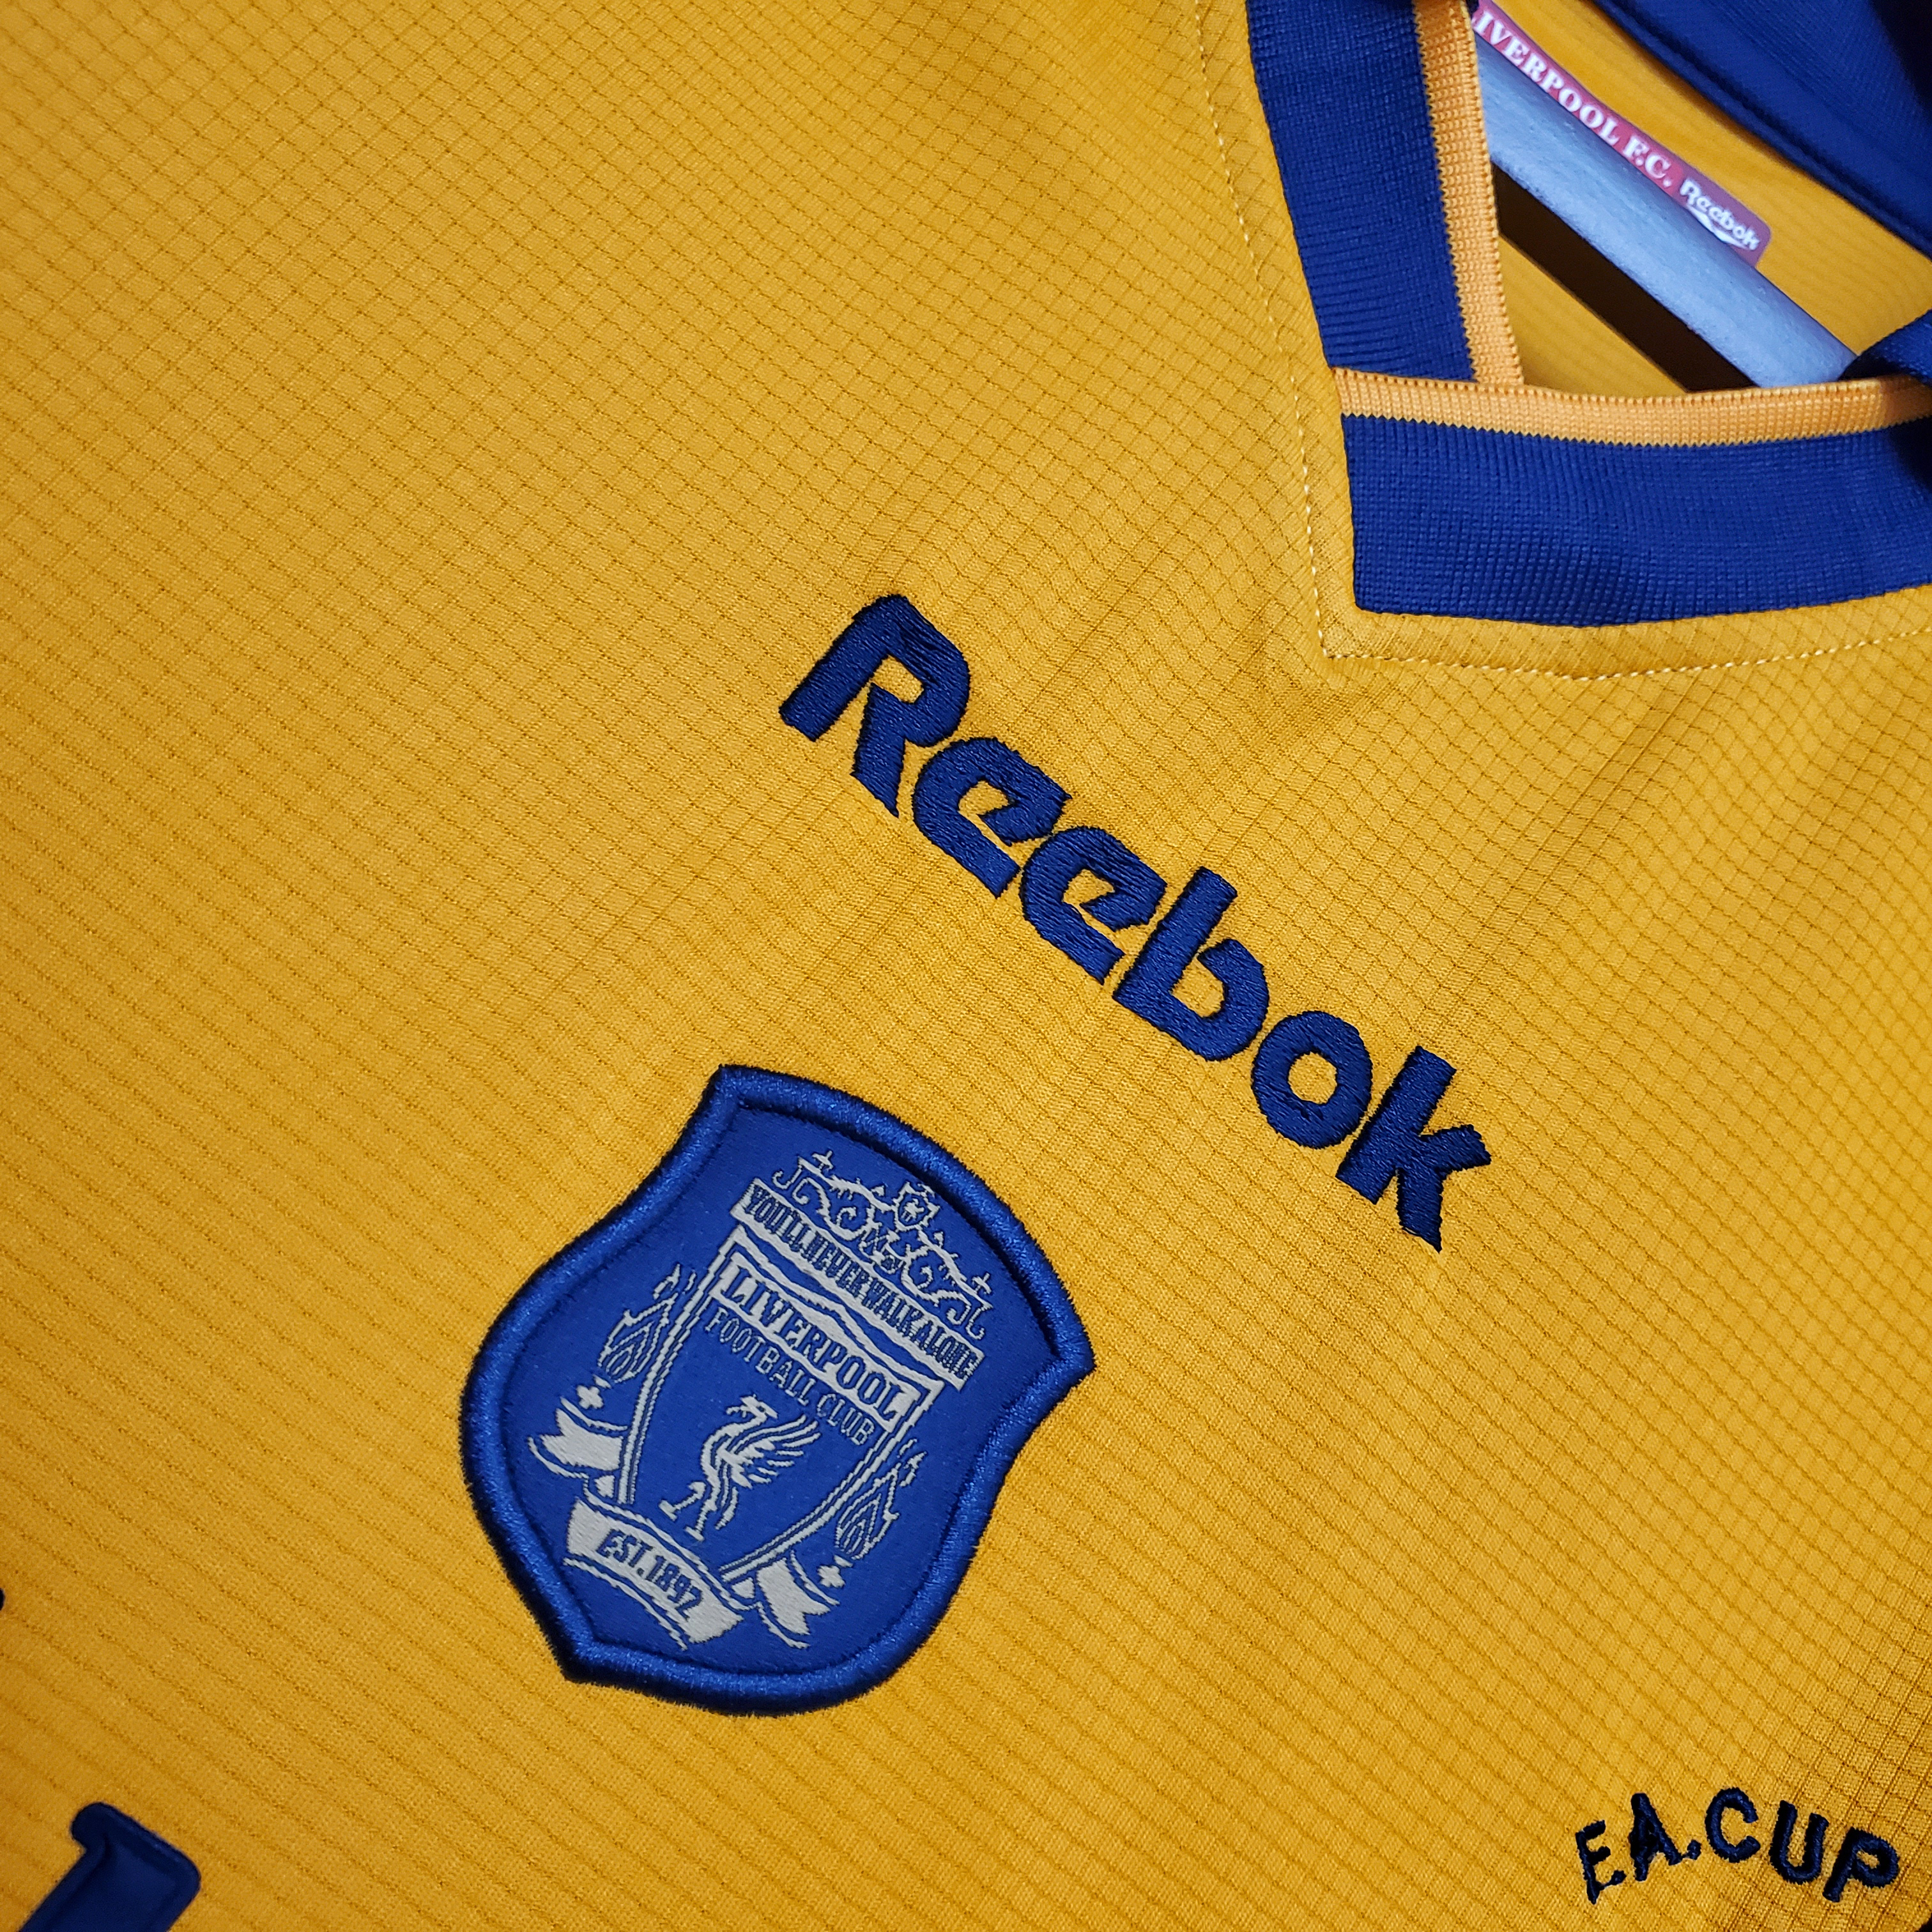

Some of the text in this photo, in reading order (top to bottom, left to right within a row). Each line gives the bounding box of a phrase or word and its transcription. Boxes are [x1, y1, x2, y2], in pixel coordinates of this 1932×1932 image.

[1471, 11, 1671, 187] IVERPOOL F.C.
[1680, 179, 1760, 250] Reebok
[779, 594, 1492, 1253] Reebok
[705, 1307, 875, 1445] FOOTBALL CLUB
[721, 1265, 903, 1420] LIVERPOOL
[805, 1234, 870, 1297] NEVER
[862, 1278, 921, 1337] WALK
[912, 1320, 979, 1381] ALONE
